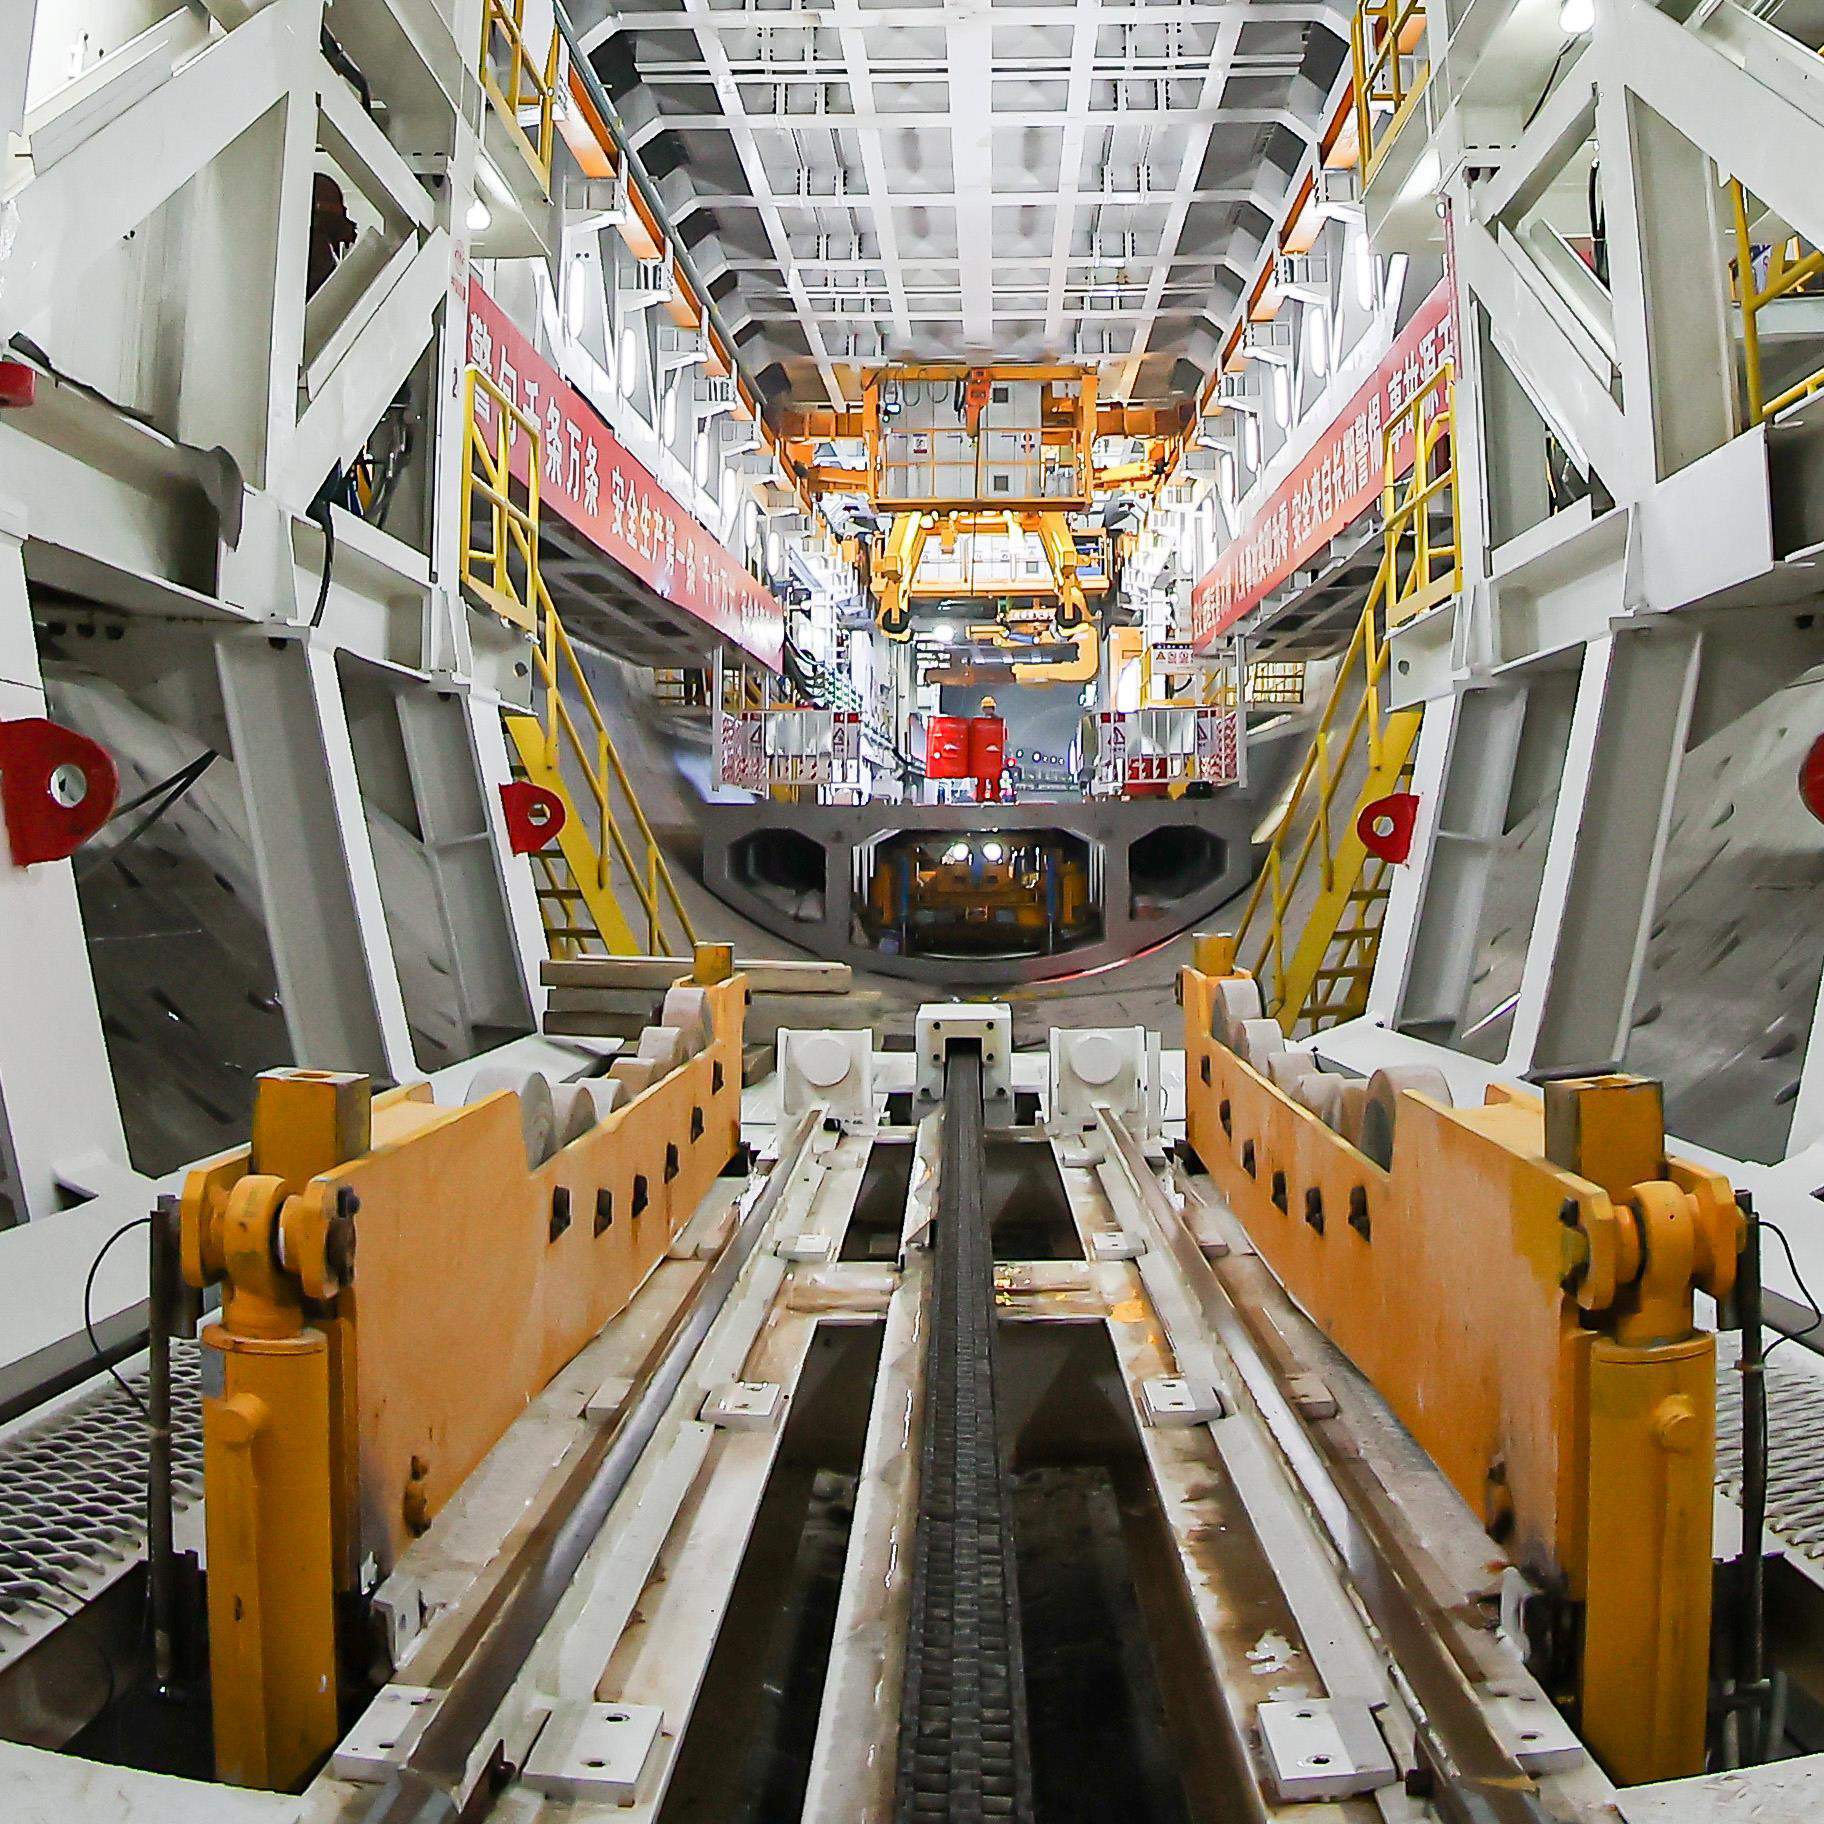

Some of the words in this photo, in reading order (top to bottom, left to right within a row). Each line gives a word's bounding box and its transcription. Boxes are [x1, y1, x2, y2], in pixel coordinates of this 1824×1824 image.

[611, 465, 697, 596] 安全生产第一条
